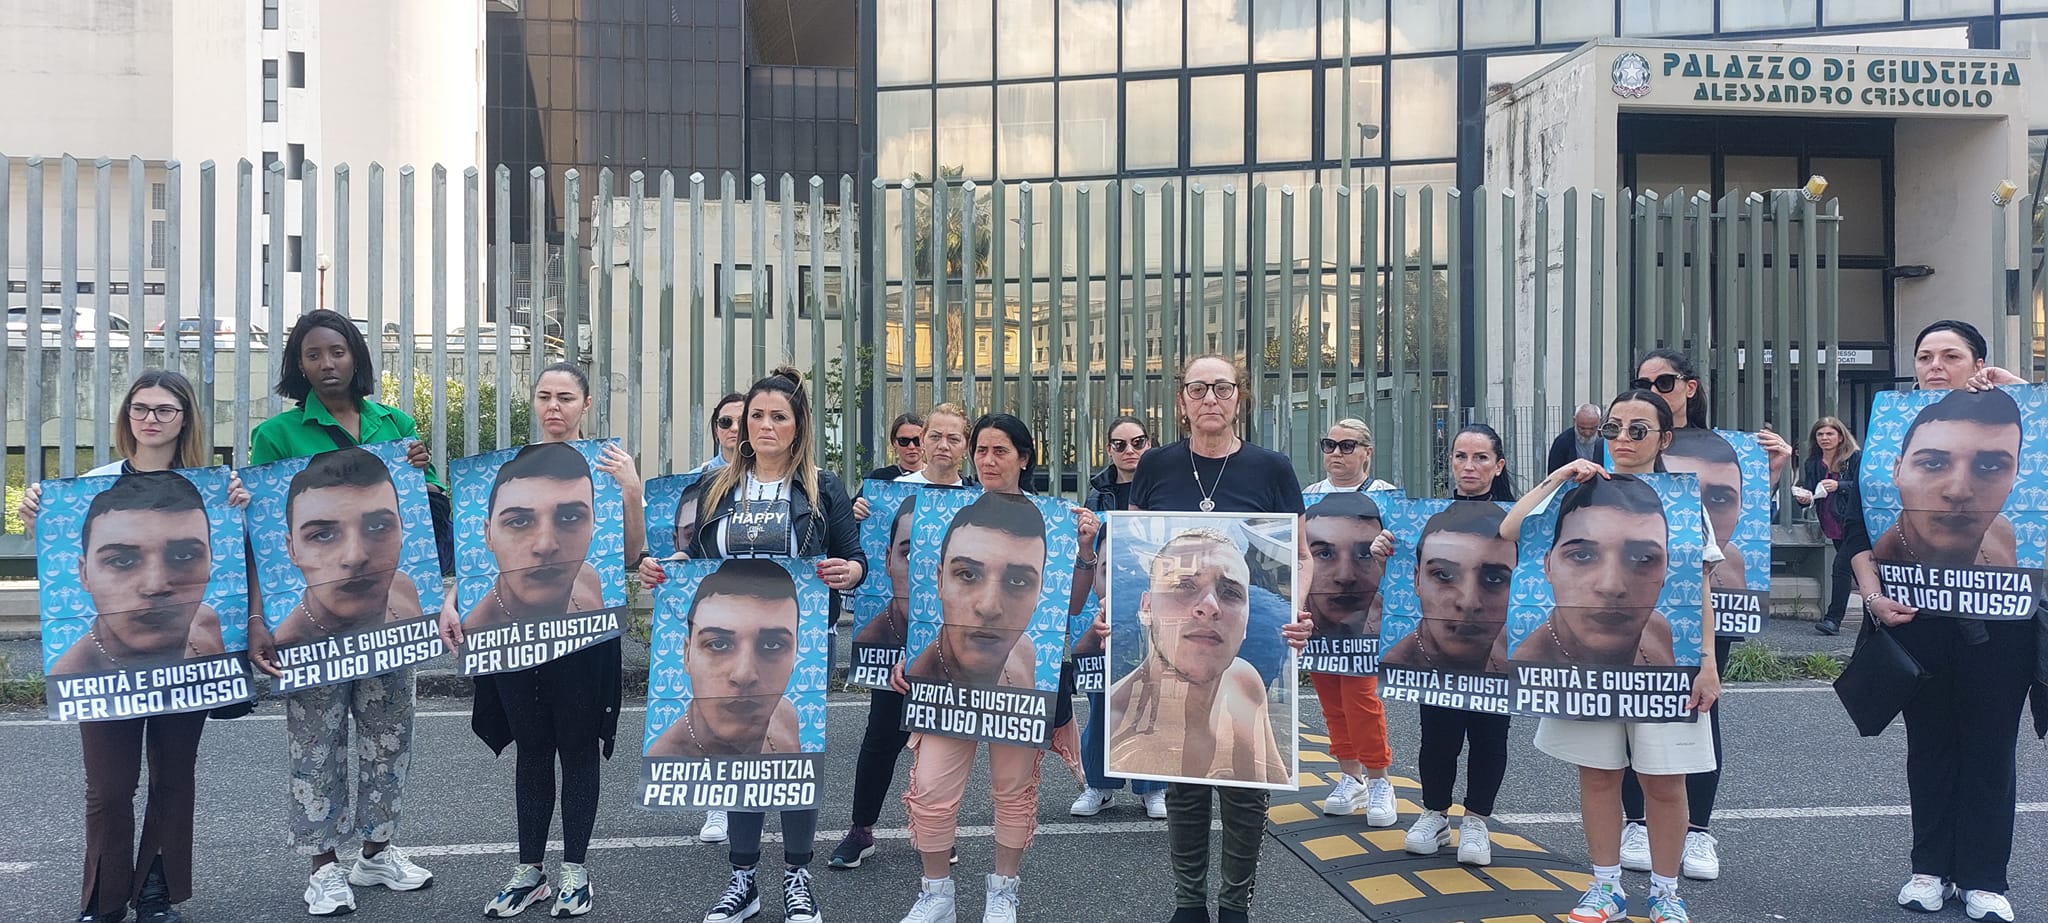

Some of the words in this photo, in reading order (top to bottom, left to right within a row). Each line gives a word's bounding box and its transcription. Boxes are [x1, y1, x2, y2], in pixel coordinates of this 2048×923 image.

[1663, 53, 1811, 81] PALAZZO
[1866, 59, 2021, 86] GIUSTIZIA
[1693, 82, 1853, 105] ALESSANDRO
[1861, 87, 1993, 108] CRISCUOLO
[731, 512, 786, 524] HAPPY
[1930, 569, 1940, 586] E
[1944, 569, 2032, 592] GIUSTIZIA
[1885, 584, 1911, 606] ER
[1914, 588, 1952, 611] UGO
[1960, 591, 2032, 616] RUSSO
[277, 637, 340, 667] VERITÀ
[344, 637, 355, 654] E
[358, 620, 440, 652] GIUSTIZIA
[467, 623, 521, 650] VERITÀ
[525, 624, 535, 642] E
[539, 613, 619, 640] GIUSTIZIA
[464, 650, 503, 675] PER
[507, 643, 547, 668] UGO
[1333, 640, 1339, 654] E
[57, 670, 131, 698] VERITÀ
[135, 671, 148, 690] E
[152, 658, 244, 687] GIUSTIZIA
[280, 664, 320, 690] PER
[326, 654, 368, 681] UGO
[374, 639, 443, 671] RUSSO
[854, 666, 888, 686] PER
[1317, 656, 1348, 672] UGO
[1076, 673, 1103, 690] PER
[1386, 668, 1440, 690] VERITÀ
[1444, 674, 1454, 690] E
[1458, 676, 1508, 696] GIUSTI
[1517, 666, 1582, 688] VERITÀ
[1586, 671, 1598, 690] E
[1602, 672, 1690, 691] GIUSTIZIA
[58, 698, 110, 721] PER
[114, 691, 164, 716] UGO
[171, 678, 248, 710] RUSSO
[911, 683, 954, 706] VERITÀ
[959, 688, 968, 707] E
[971, 690, 1046, 716] GIUSTIZIA
[1382, 686, 1420, 702] PER
[1424, 690, 1464, 708] UGO
[1470, 696, 1508, 714] RUS
[1516, 688, 1560, 714] PER
[1566, 692, 1610, 716] UGO
[1619, 694, 1691, 718] RUSSO
[905, 704, 936, 730] PER
[942, 708, 977, 734] UGO
[981, 713, 1046, 744] RUSSO
[651, 758, 712, 780] VERITÀ
[716, 762, 728, 780] E
[731, 760, 815, 780] GIUSTIZIA
[644, 784, 688, 806] PER
[692, 784, 738, 806] UGO
[743, 782, 816, 806] RUSSO
